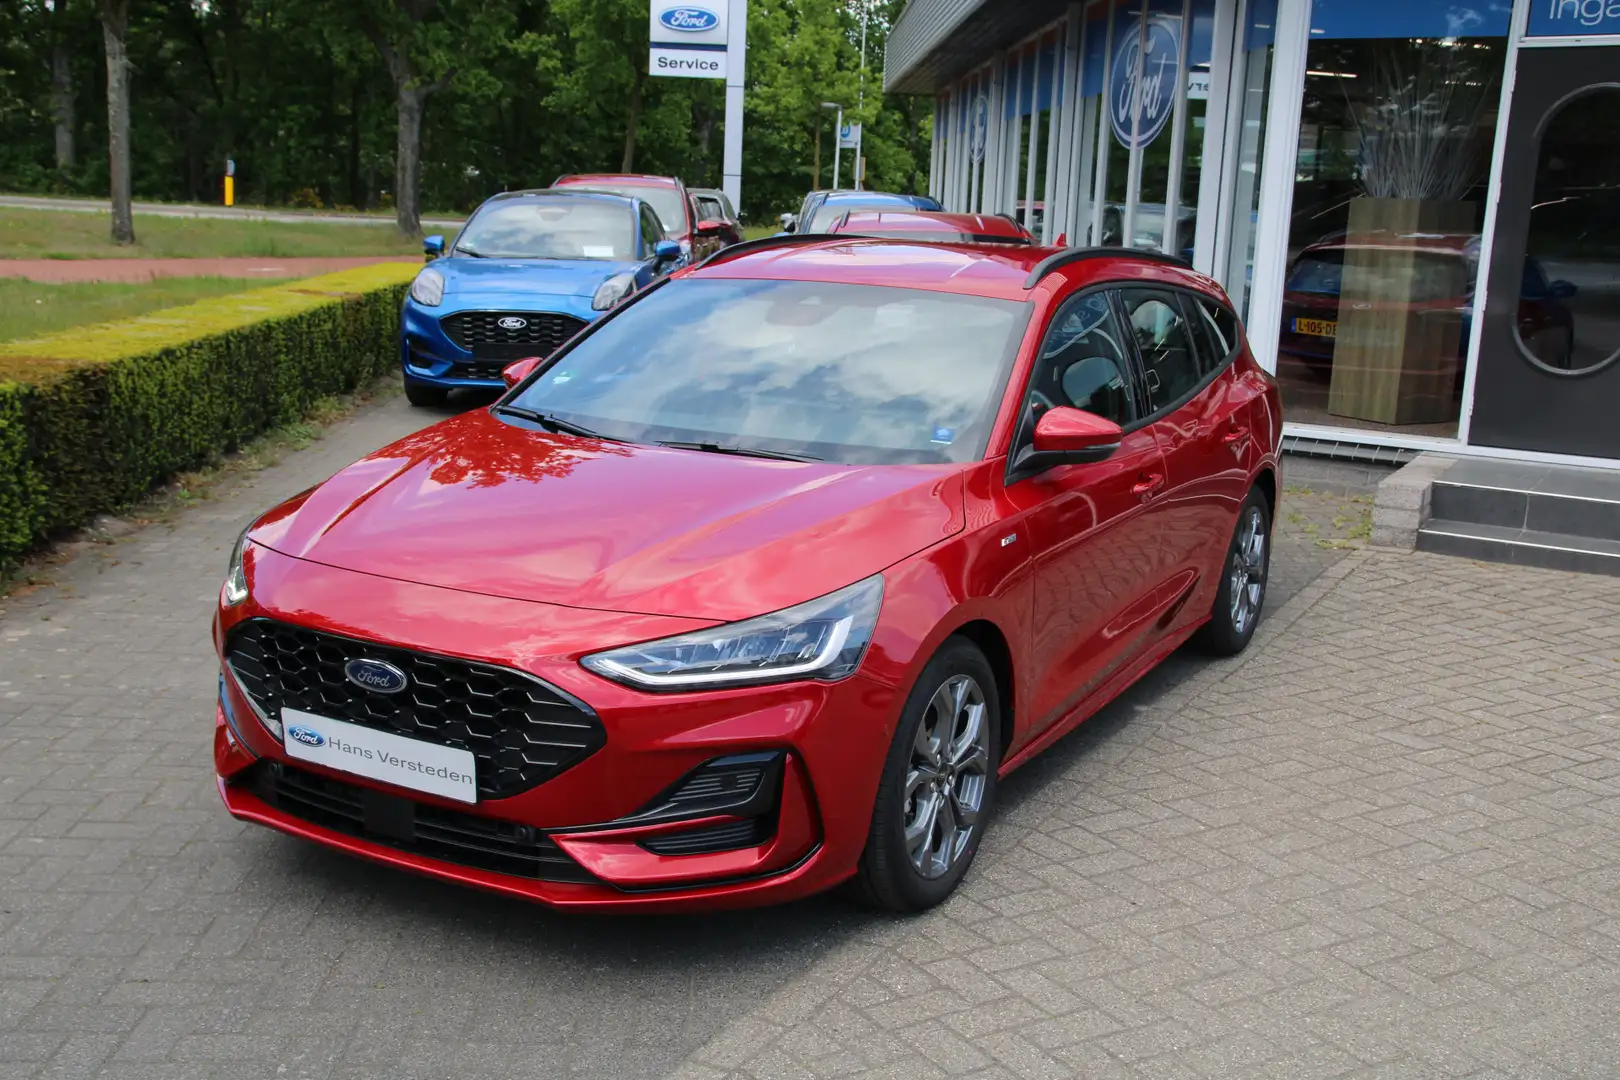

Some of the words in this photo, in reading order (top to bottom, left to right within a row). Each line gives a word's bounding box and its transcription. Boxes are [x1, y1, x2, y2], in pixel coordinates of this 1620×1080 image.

[670, 9, 708, 27] Ford
[657, 56, 719, 71] Service
[357, 664, 392, 689] Ford
[293, 726, 319, 745] Ford
[328, 736, 373, 760] Hans
[377, 749, 473, 785] Versteden
